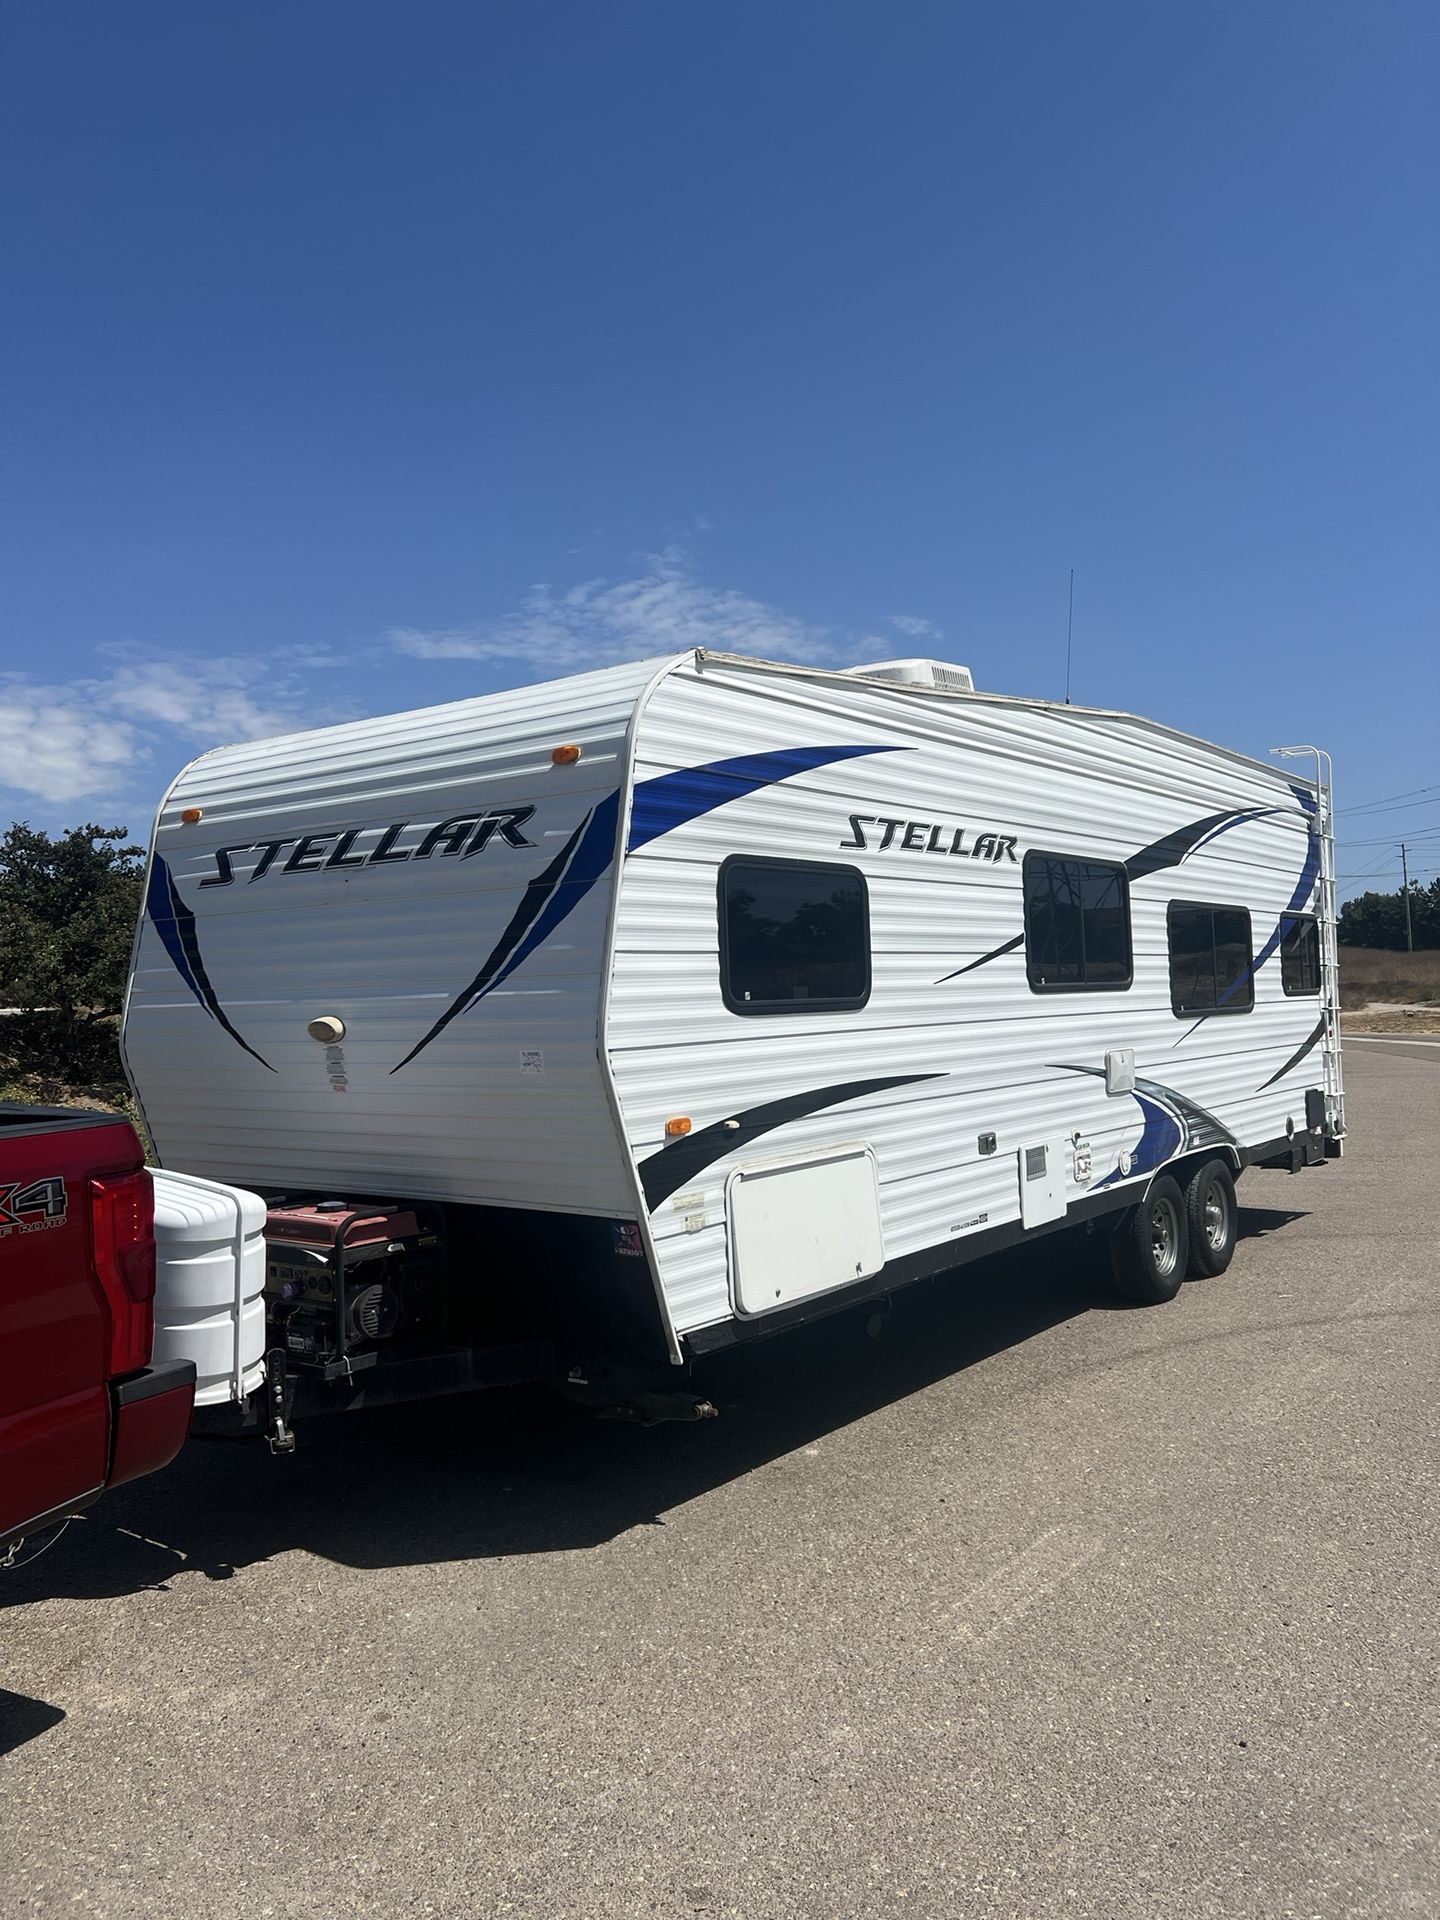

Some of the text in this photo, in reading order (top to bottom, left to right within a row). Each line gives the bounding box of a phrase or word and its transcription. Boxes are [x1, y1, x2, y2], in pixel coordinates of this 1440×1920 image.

[196, 804, 539, 889] STELLAR
[838, 814, 1020, 864] STELLAR
[19, 1217, 67, 1234] ROAD
